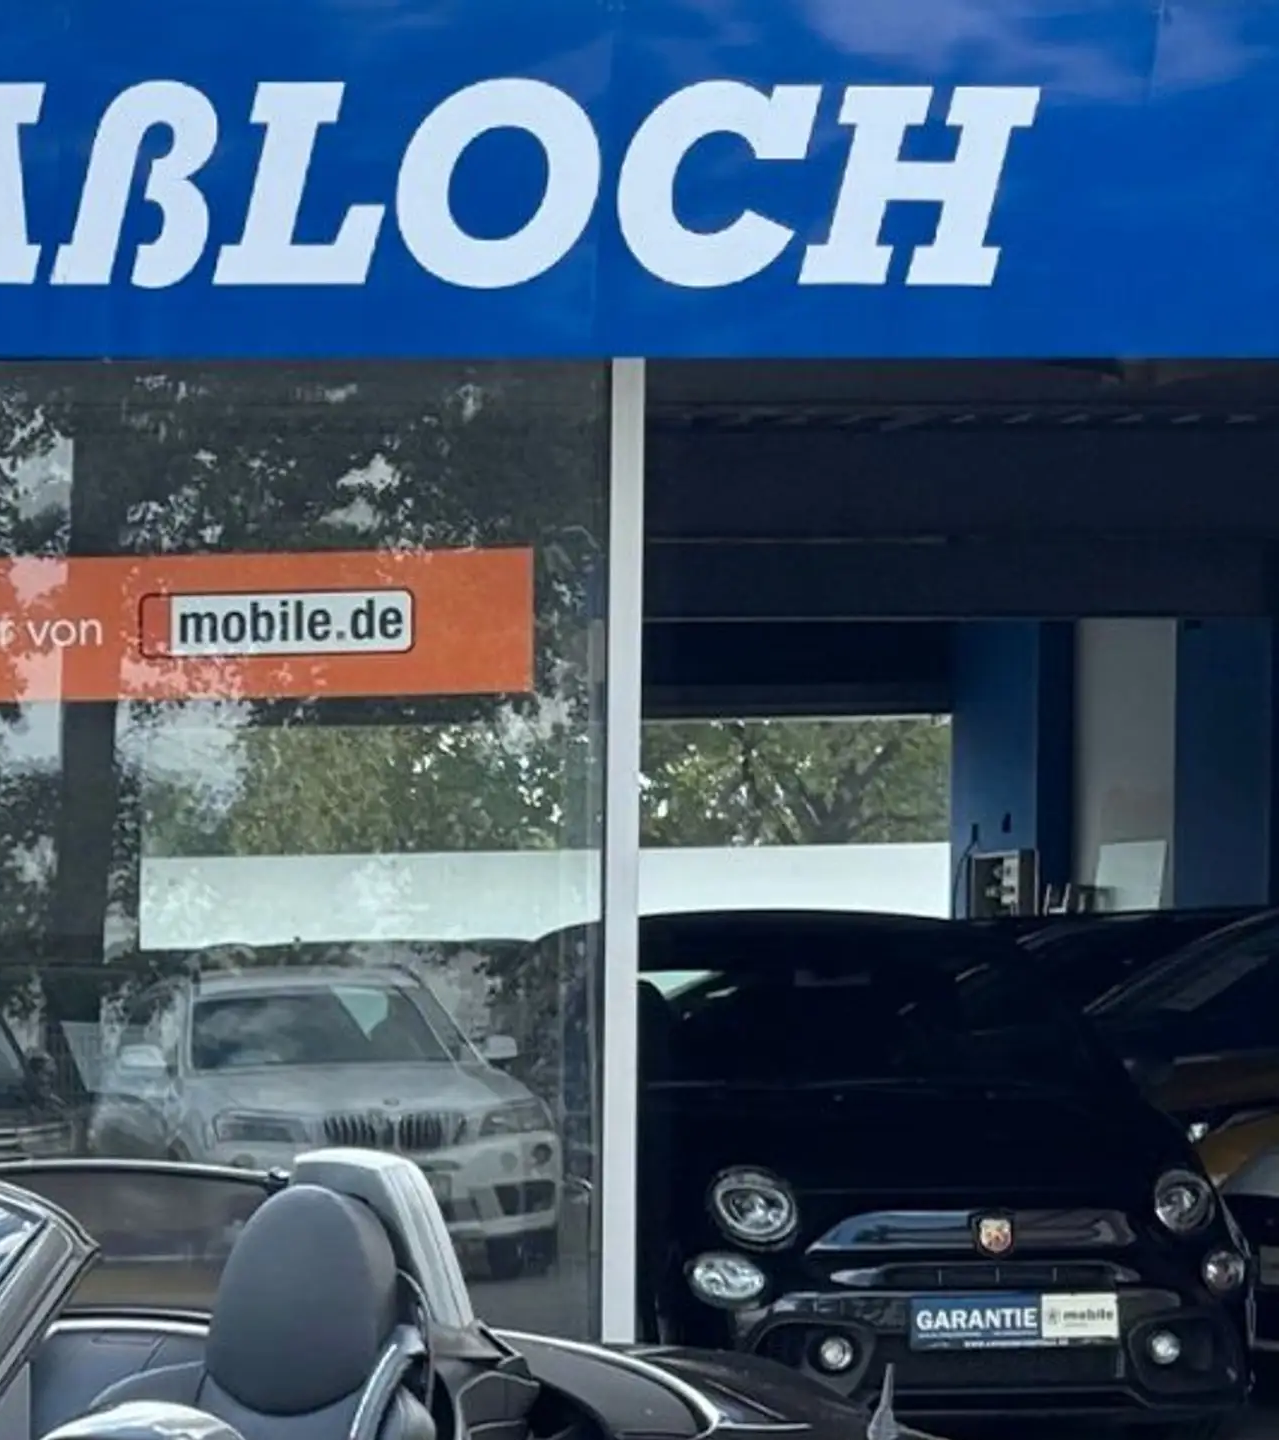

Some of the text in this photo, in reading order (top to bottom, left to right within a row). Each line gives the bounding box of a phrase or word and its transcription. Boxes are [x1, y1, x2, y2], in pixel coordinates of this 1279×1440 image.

[28, 619, 103, 648] von
[179, 599, 404, 645] mobile.de
[916, 1307, 1038, 1331] GARANTIE
